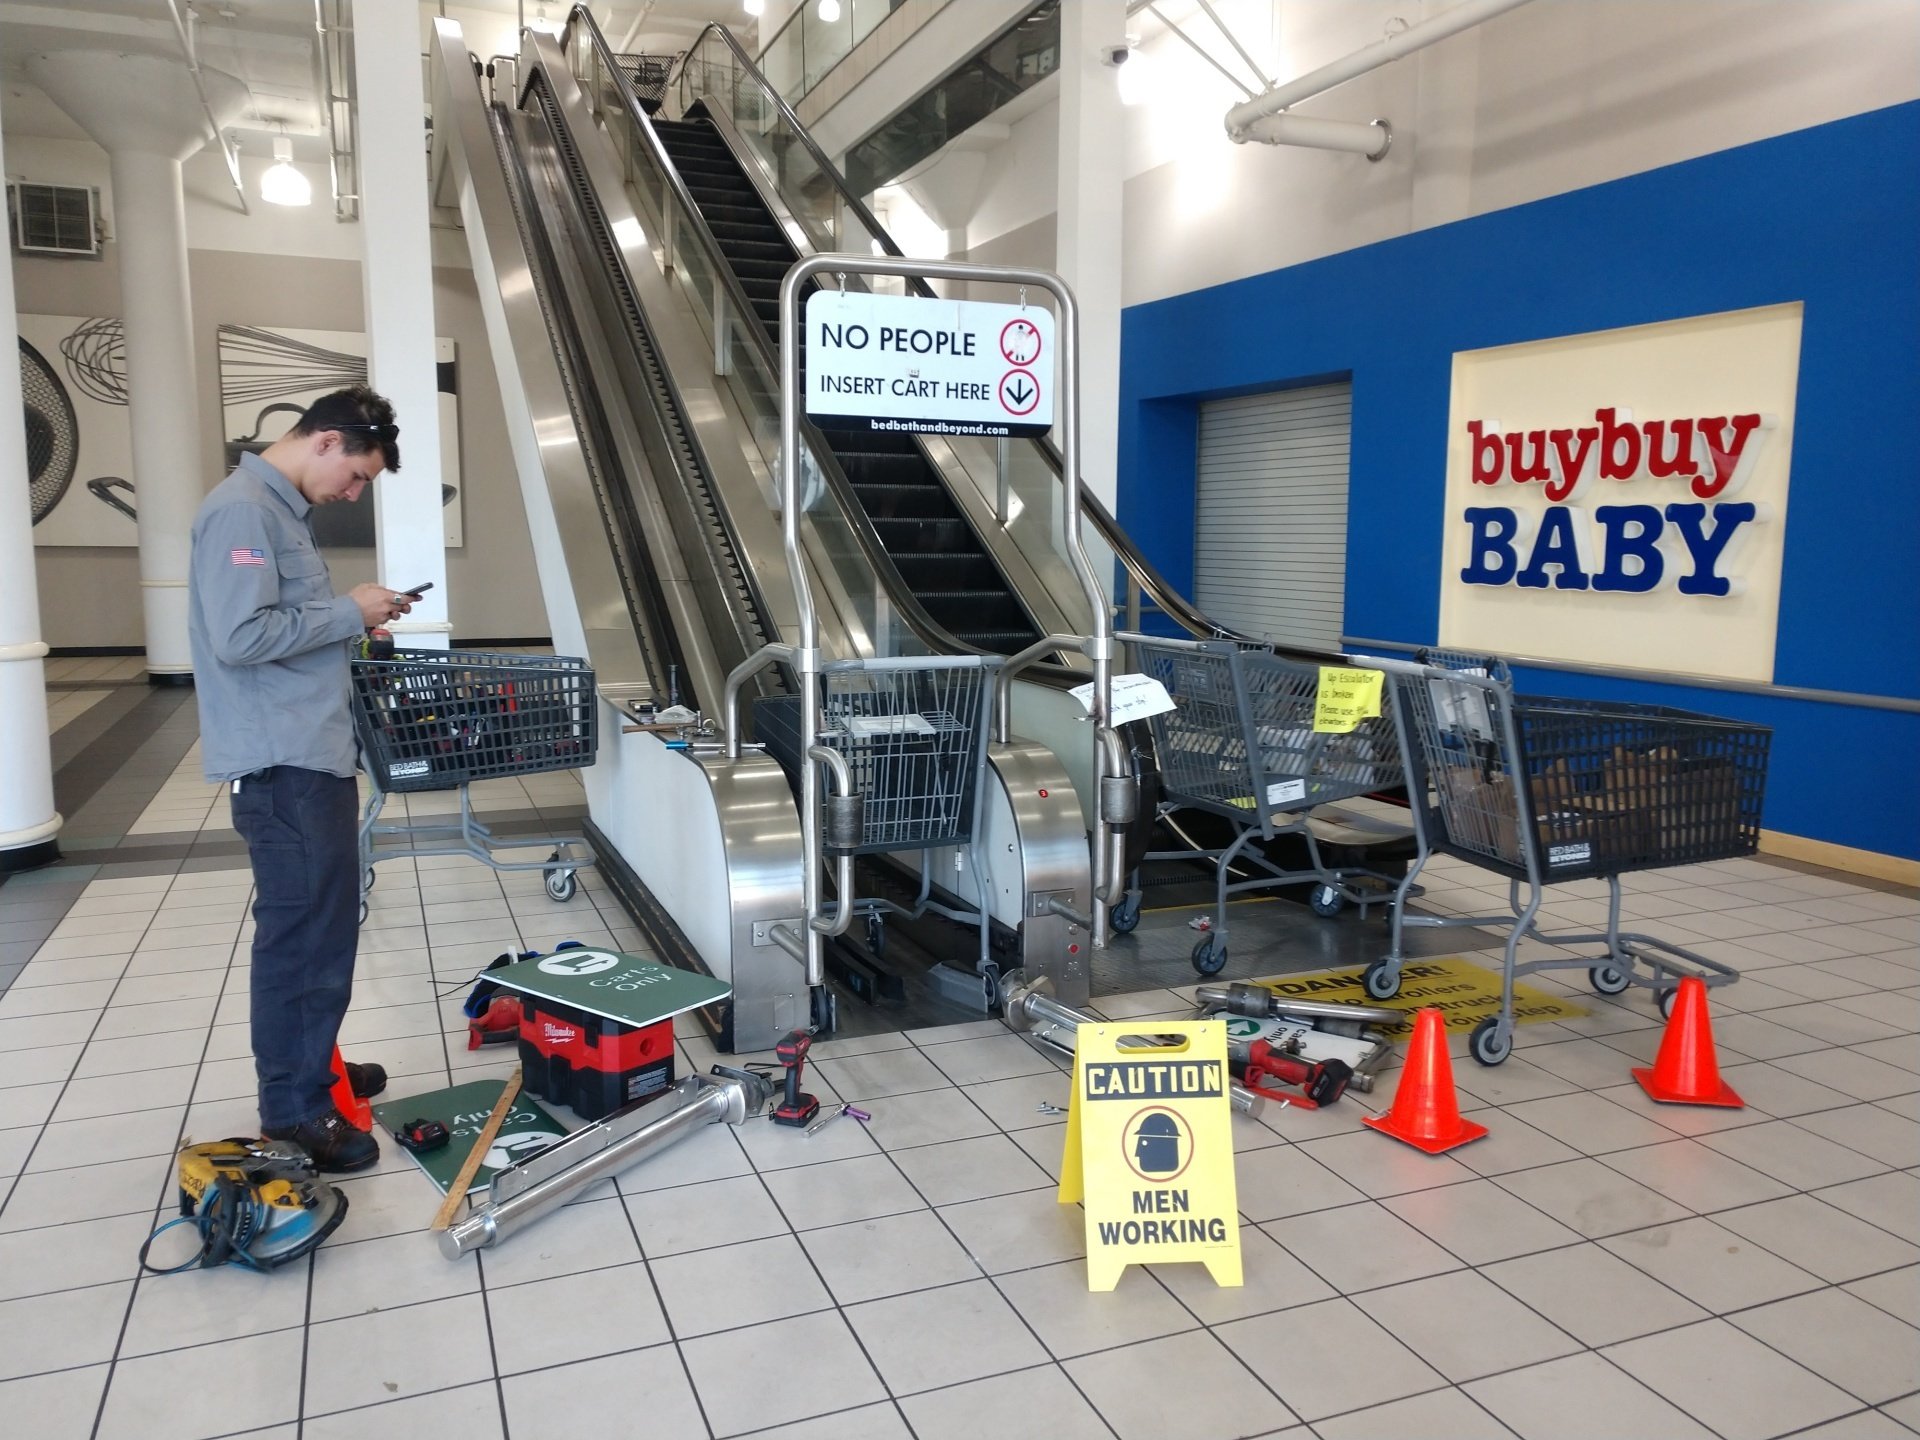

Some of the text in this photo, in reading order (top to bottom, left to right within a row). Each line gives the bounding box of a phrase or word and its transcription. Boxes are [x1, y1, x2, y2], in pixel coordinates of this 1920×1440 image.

[821, 322, 976, 357] NO PEOPLE
[821, 374, 990, 401] INSERT CART HERE
[871, 418, 1009, 436] bedbathandbeyond.com
[1467, 407, 1761, 503] buybuy
[1460, 502, 1757, 597] BABY
[1327, 673, 1376, 685] Up Escalator
[589, 966, 659, 987] Carts
[615, 973, 672, 991] Only
[1273, 965, 1453, 995] DANER!
[1385, 983, 1478, 1001] rollers
[1444, 1010, 1494, 1027] our
[1263, 1027, 1288, 1043] only
[1088, 1064, 1221, 1095] CAUTION
[452, 1113, 537, 1137] Cats
[1132, 1189, 1190, 1214] MEN
[1098, 1217, 1227, 1246] WORKING
